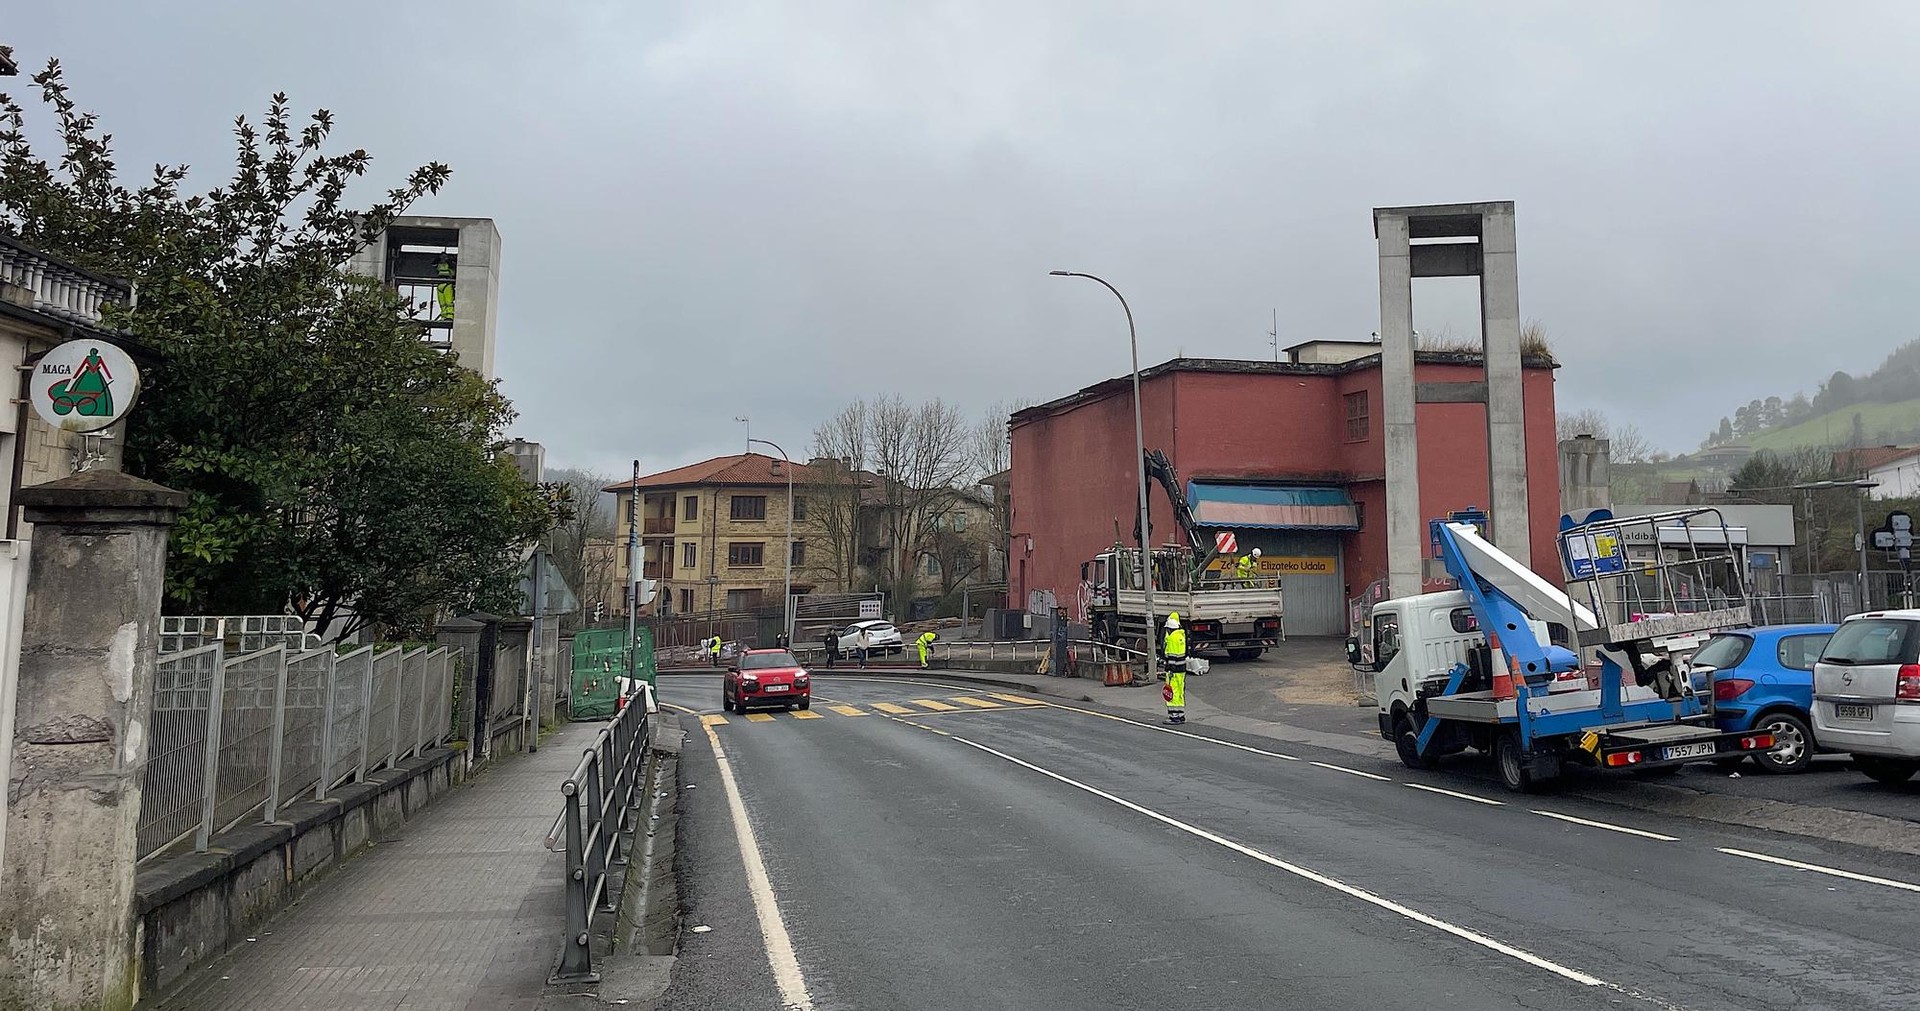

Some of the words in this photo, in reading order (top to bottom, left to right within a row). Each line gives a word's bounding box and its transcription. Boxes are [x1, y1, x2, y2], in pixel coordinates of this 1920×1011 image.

[42, 364, 71, 374] MAGA
[1617, 531, 1656, 540] aldiba
[1261, 560, 1298, 571] Elizateko
[1300, 561, 1325, 571] Udala
[1669, 745, 1692, 757] 7557
[1696, 743, 1713, 754] JPN
